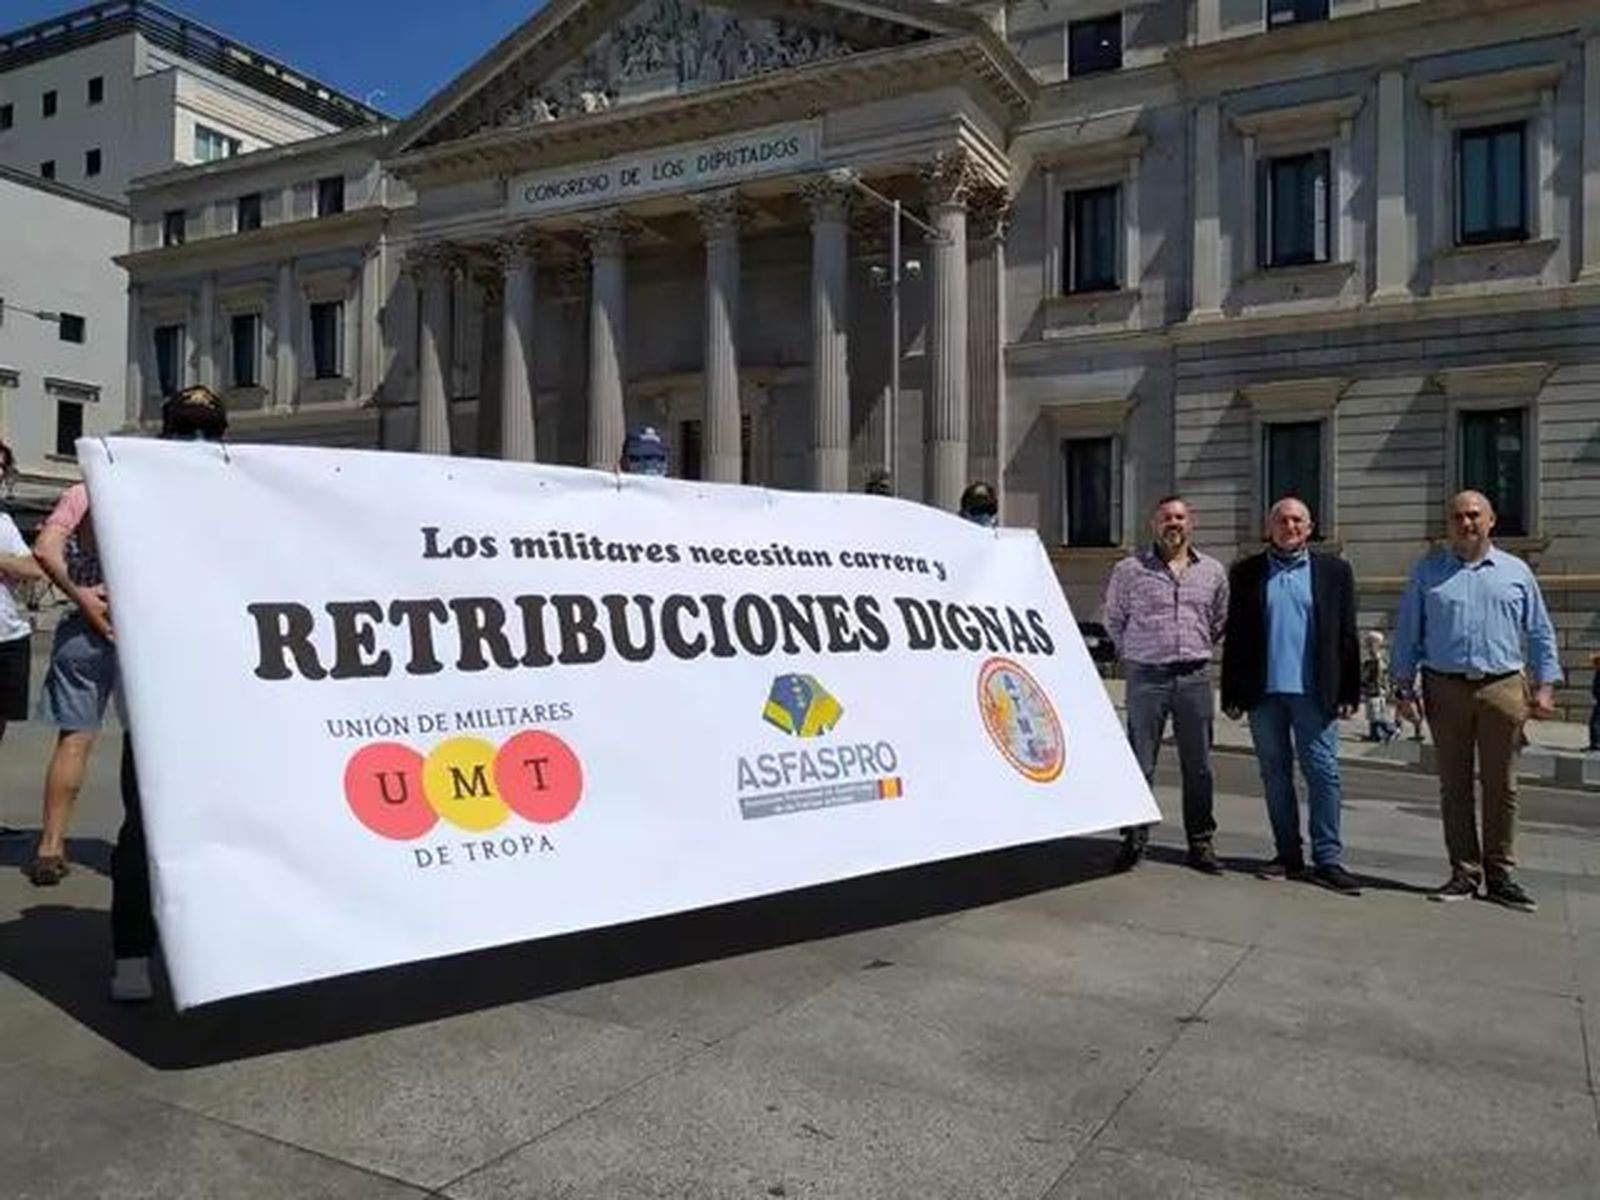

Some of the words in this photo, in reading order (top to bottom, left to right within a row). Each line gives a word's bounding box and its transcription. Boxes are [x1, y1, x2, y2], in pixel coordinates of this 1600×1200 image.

[524, 173, 610, 204] CONGRESO
[620, 167, 641, 187] DE
[652, 159, 684, 180] LOS
[697, 137, 799, 174] DIPUTADOS
[422, 527, 498, 560] Los
[511, 532, 681, 564] militares
[691, 544, 833, 569] necesitan
[841, 550, 930, 575] carrera
[934, 558, 948, 581] y
[248, 594, 890, 680] RETRIBUCIONES
[895, 597, 1054, 656] DIGNAS
[327, 714, 410, 738] UNIÓN
[418, 714, 449, 733] DE
[456, 702, 574, 731] MILITARES
[737, 741, 898, 791] ASFASPRO
[414, 844, 452, 868] DE
[463, 834, 555, 861] TROPA
